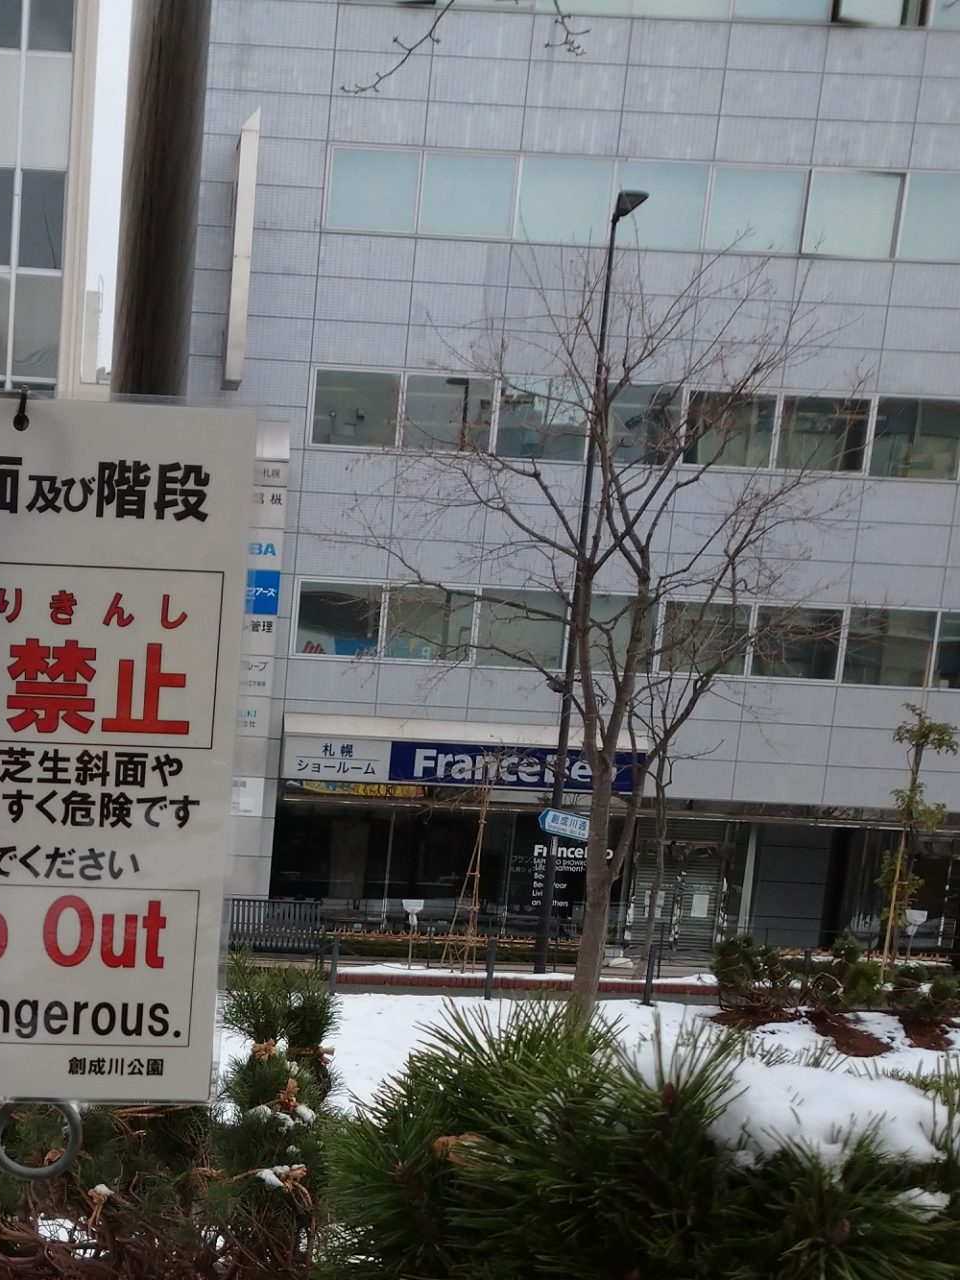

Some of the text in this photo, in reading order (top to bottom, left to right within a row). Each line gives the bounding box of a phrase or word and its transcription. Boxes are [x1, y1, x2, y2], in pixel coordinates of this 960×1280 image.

[322, 743, 354, 758] 札幌
[297, 759, 376, 775] ショールーム
[42, 894, 167, 969] Out
[68, 1056, 164, 1077] 創成川公園
